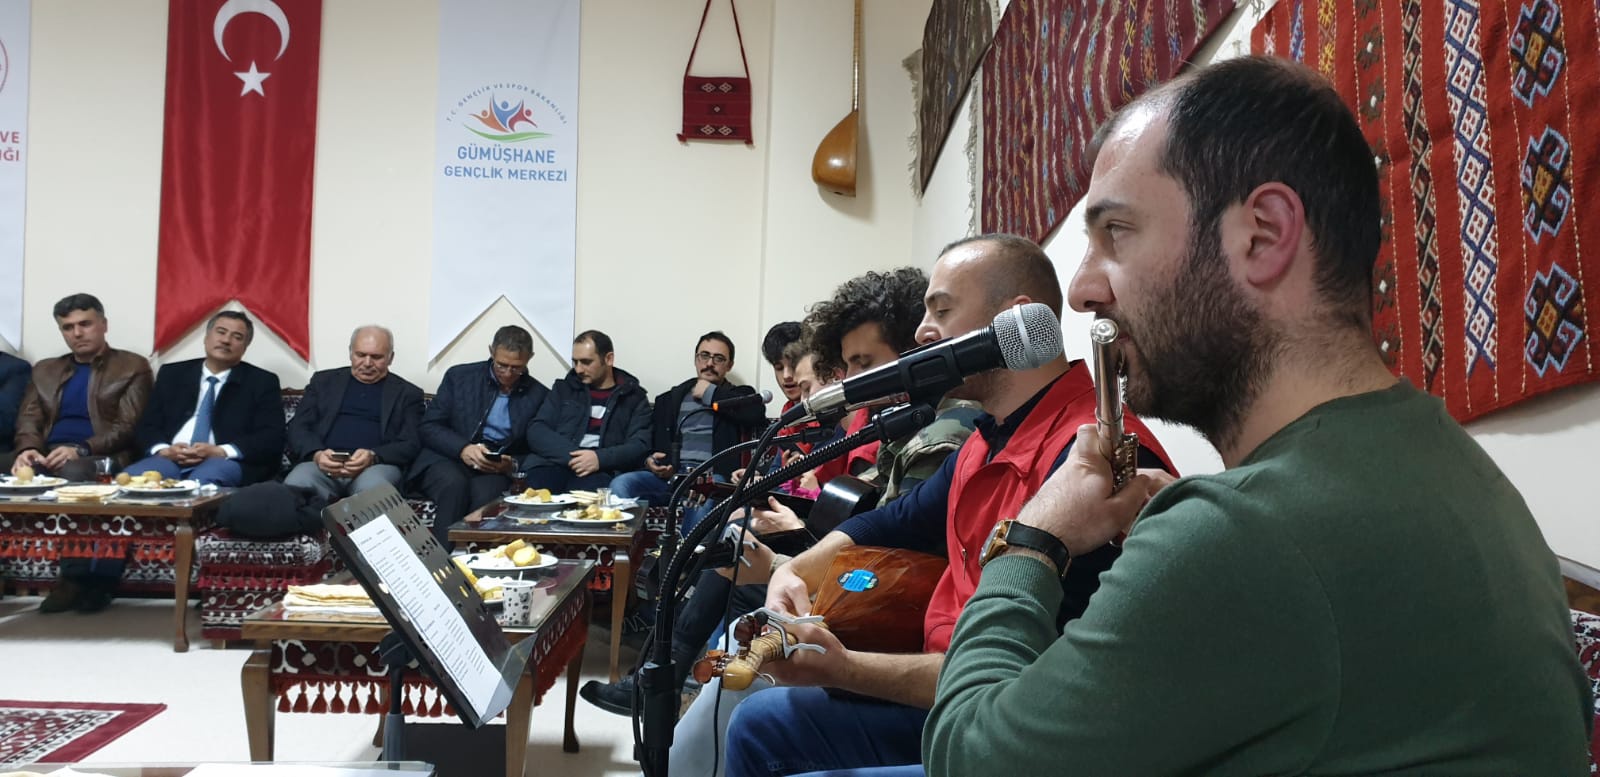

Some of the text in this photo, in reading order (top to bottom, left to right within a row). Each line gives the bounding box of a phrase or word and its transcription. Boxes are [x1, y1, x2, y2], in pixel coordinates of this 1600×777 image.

[506, 83, 528, 92] SPOR
[0, 131, 20, 144] VE
[457, 143, 556, 164] GÜMÜŞHANE
[444, 165, 567, 182] GENÇLİK MERKEZİ
